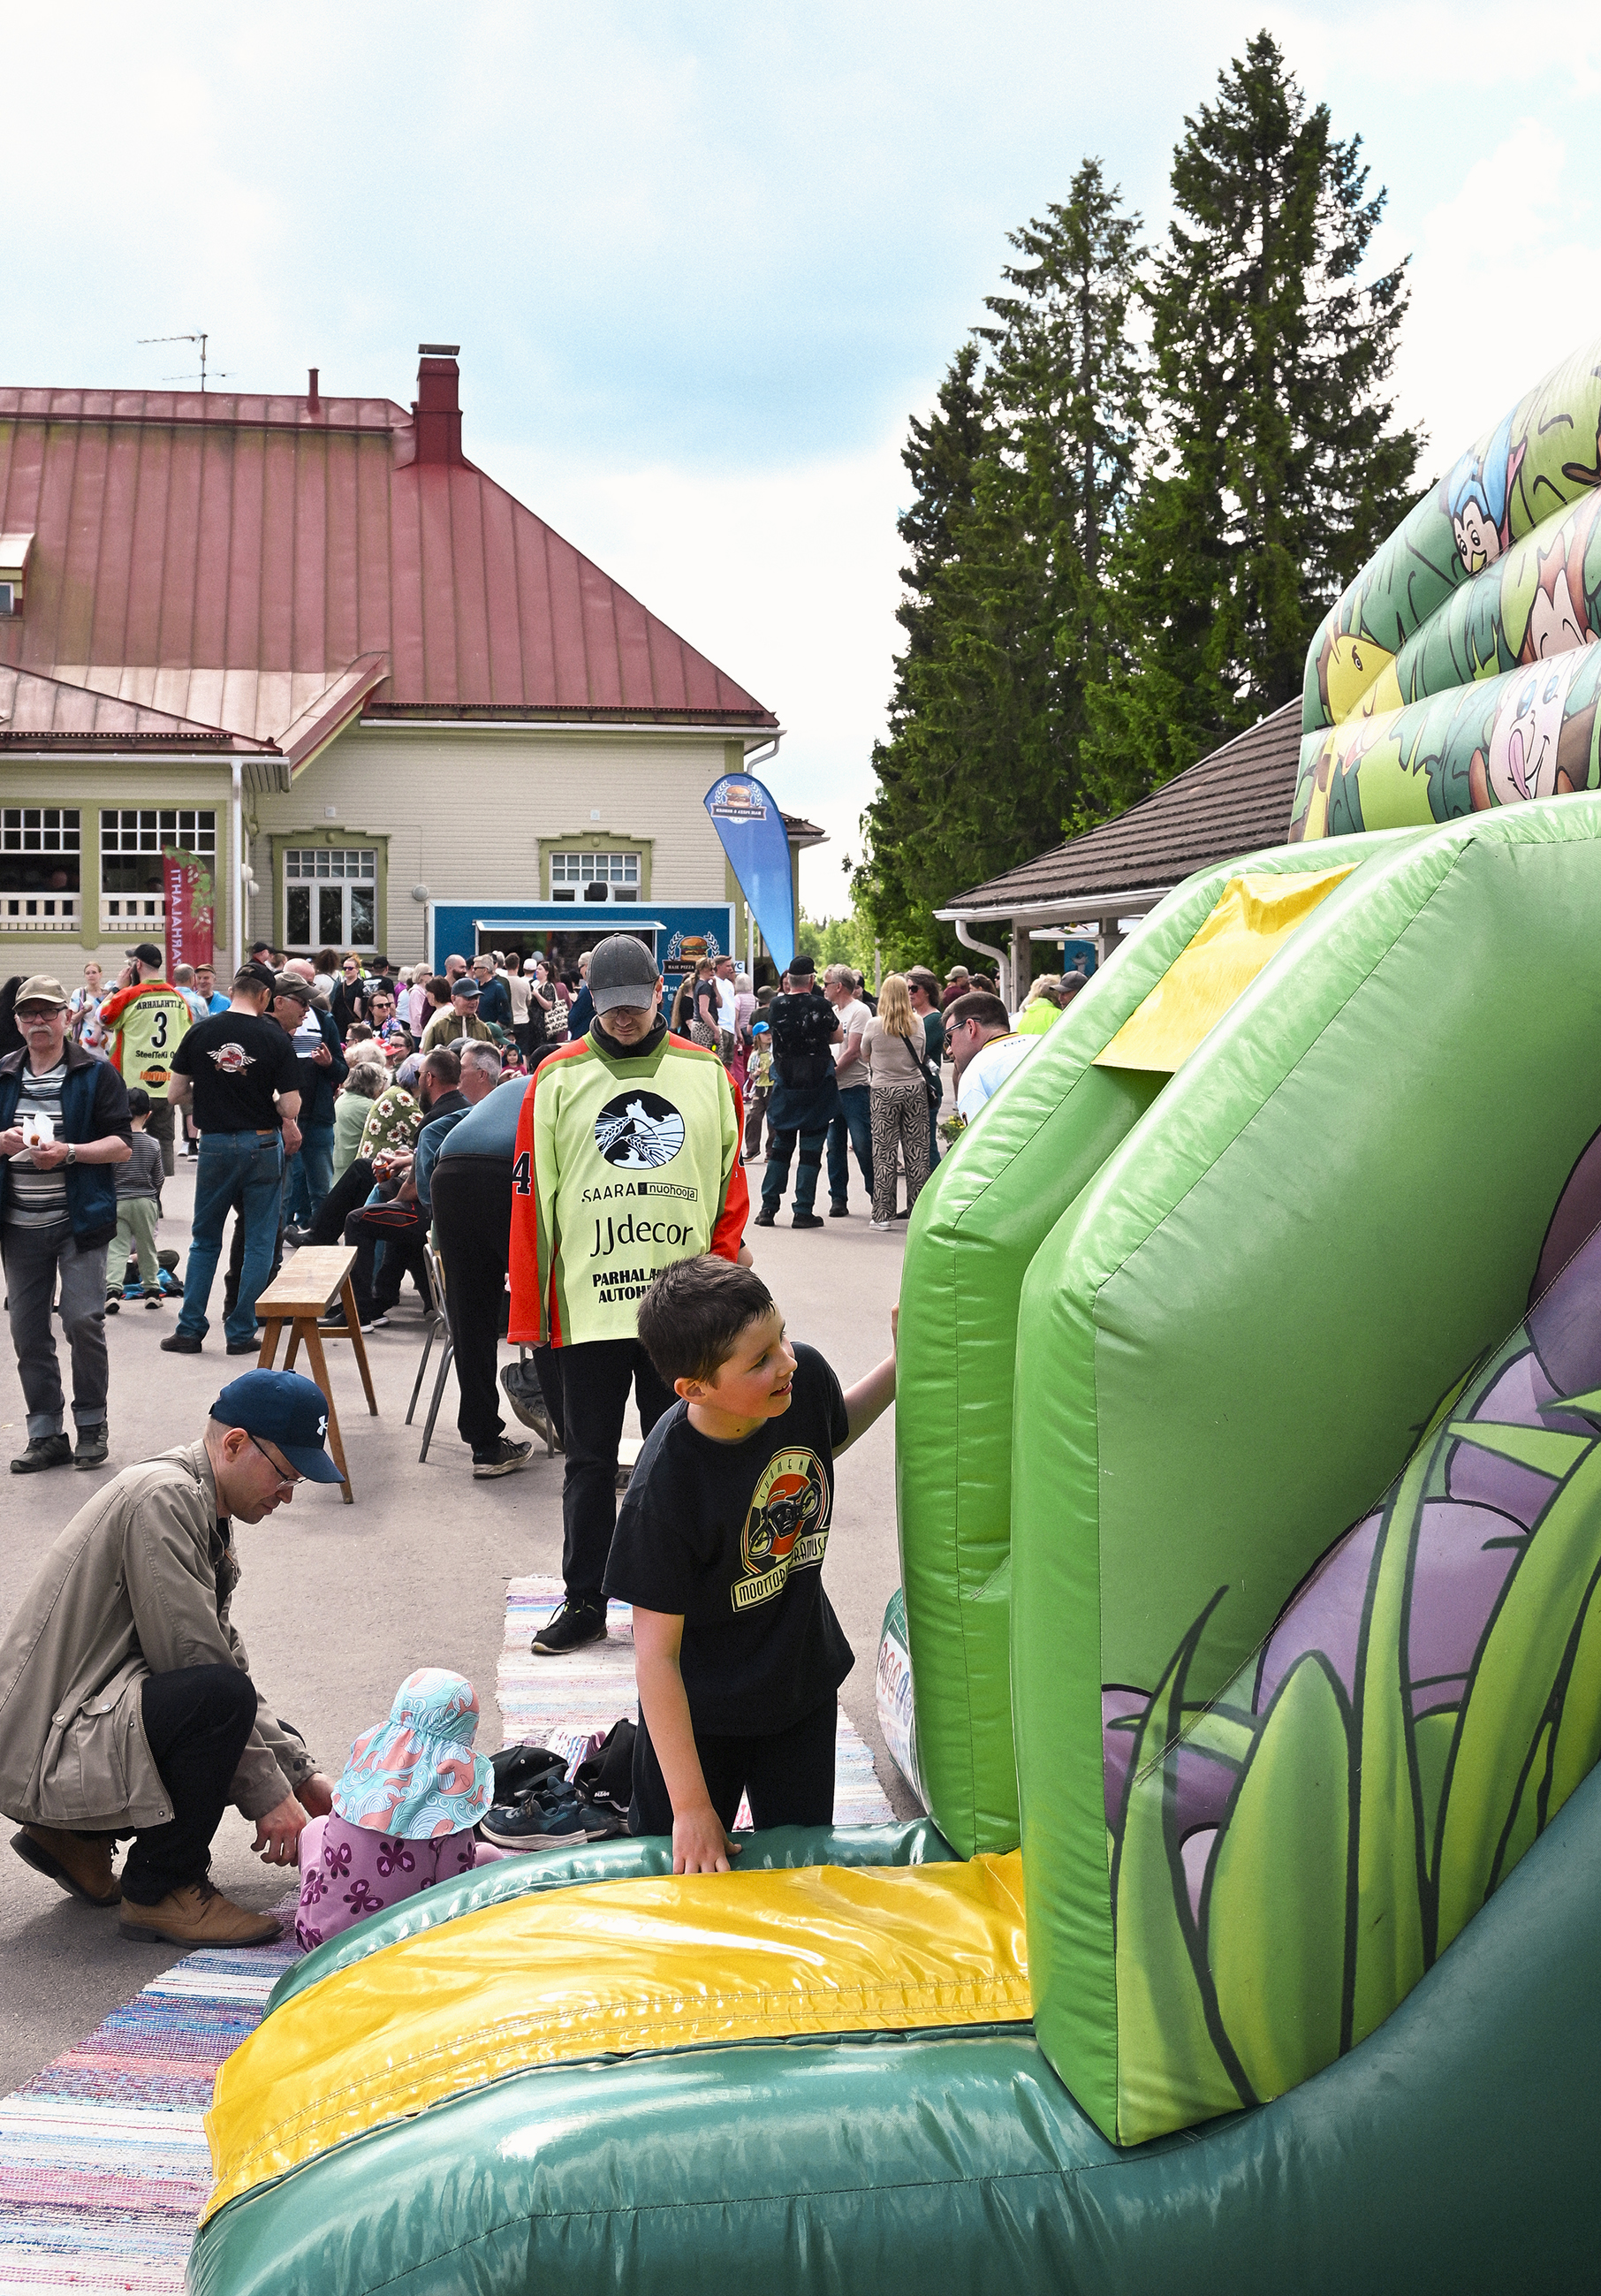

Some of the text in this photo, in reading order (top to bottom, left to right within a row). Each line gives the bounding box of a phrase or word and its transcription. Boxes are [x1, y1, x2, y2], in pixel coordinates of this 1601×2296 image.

[135, 1000, 177, 1010] ARHALAHTI
[150, 1011, 168, 1048] 3
[512, 1152, 532, 1196] 4
[581, 1182, 695, 1203] SAARA nuohooja
[592, 1268, 663, 1288] PARHALAH
[759, 1458, 804, 1500] SUOMEN
